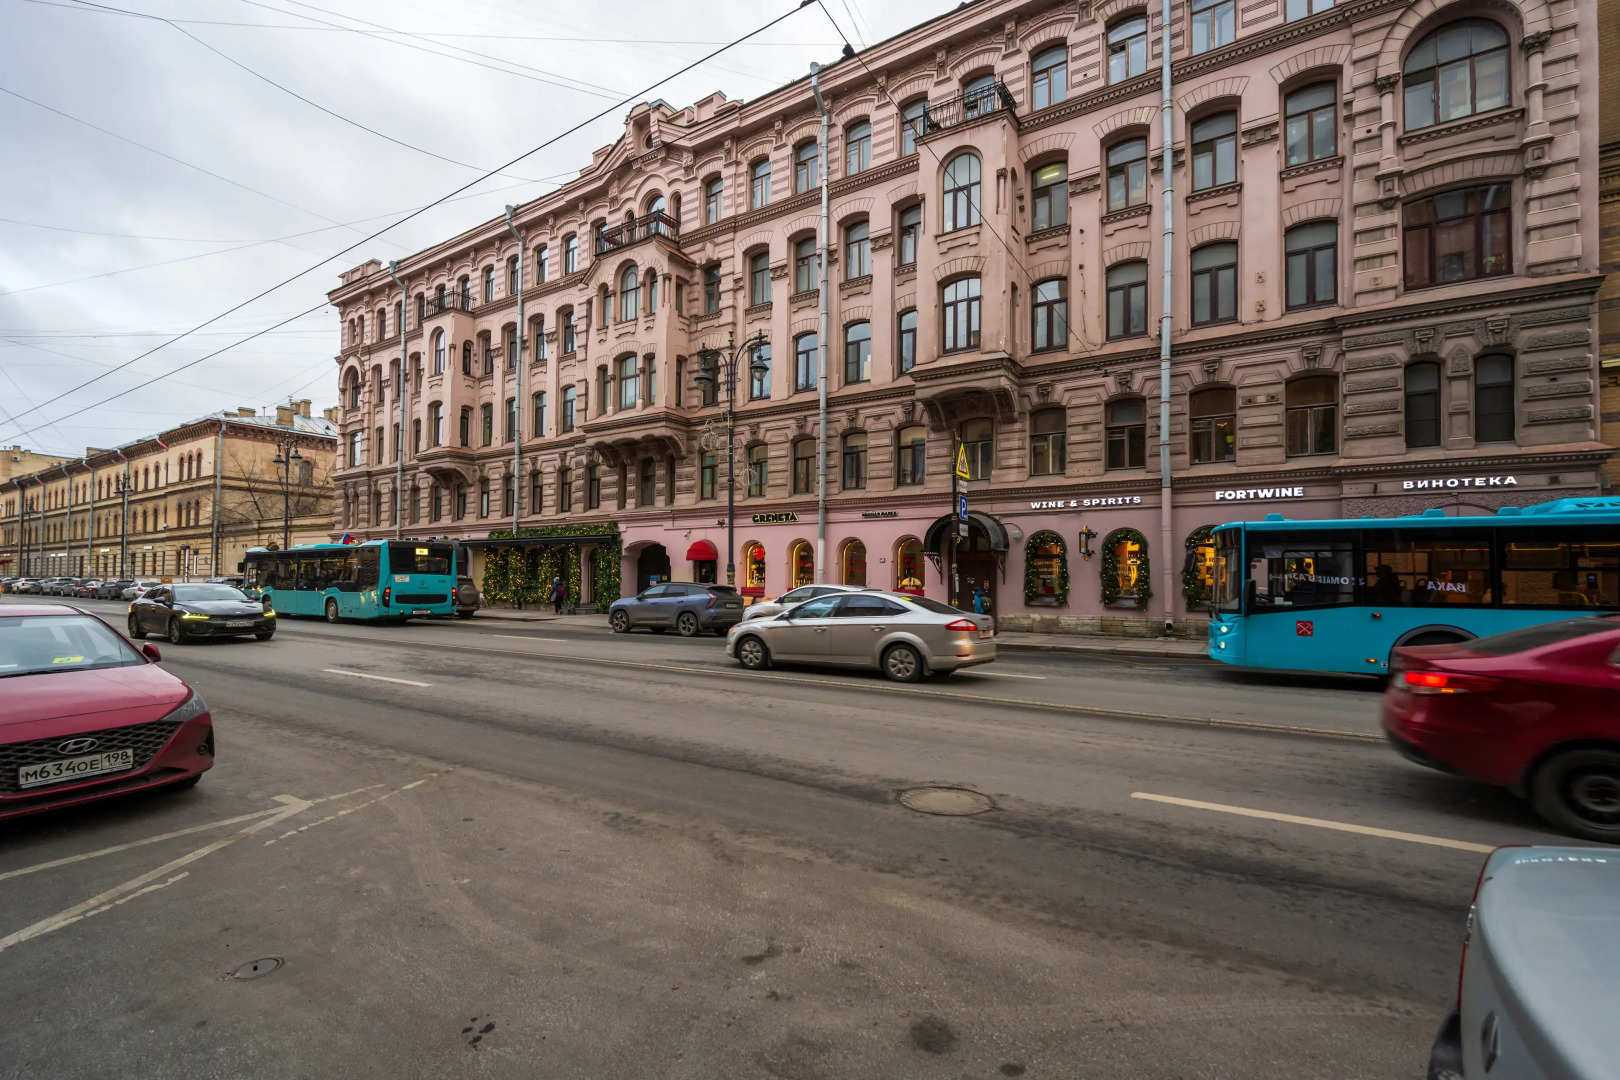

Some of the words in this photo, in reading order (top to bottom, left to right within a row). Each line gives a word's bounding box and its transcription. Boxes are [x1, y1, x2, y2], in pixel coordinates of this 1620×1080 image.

[1403, 475, 1518, 489] ВИНОТЕКА
[1215, 486, 1304, 501] FORTWINE
[1030, 498, 1065, 509] WINE
[1069, 498, 1078, 509] &
[1082, 495, 1142, 508] SPIRITS
[104, 751, 129, 764] 198
